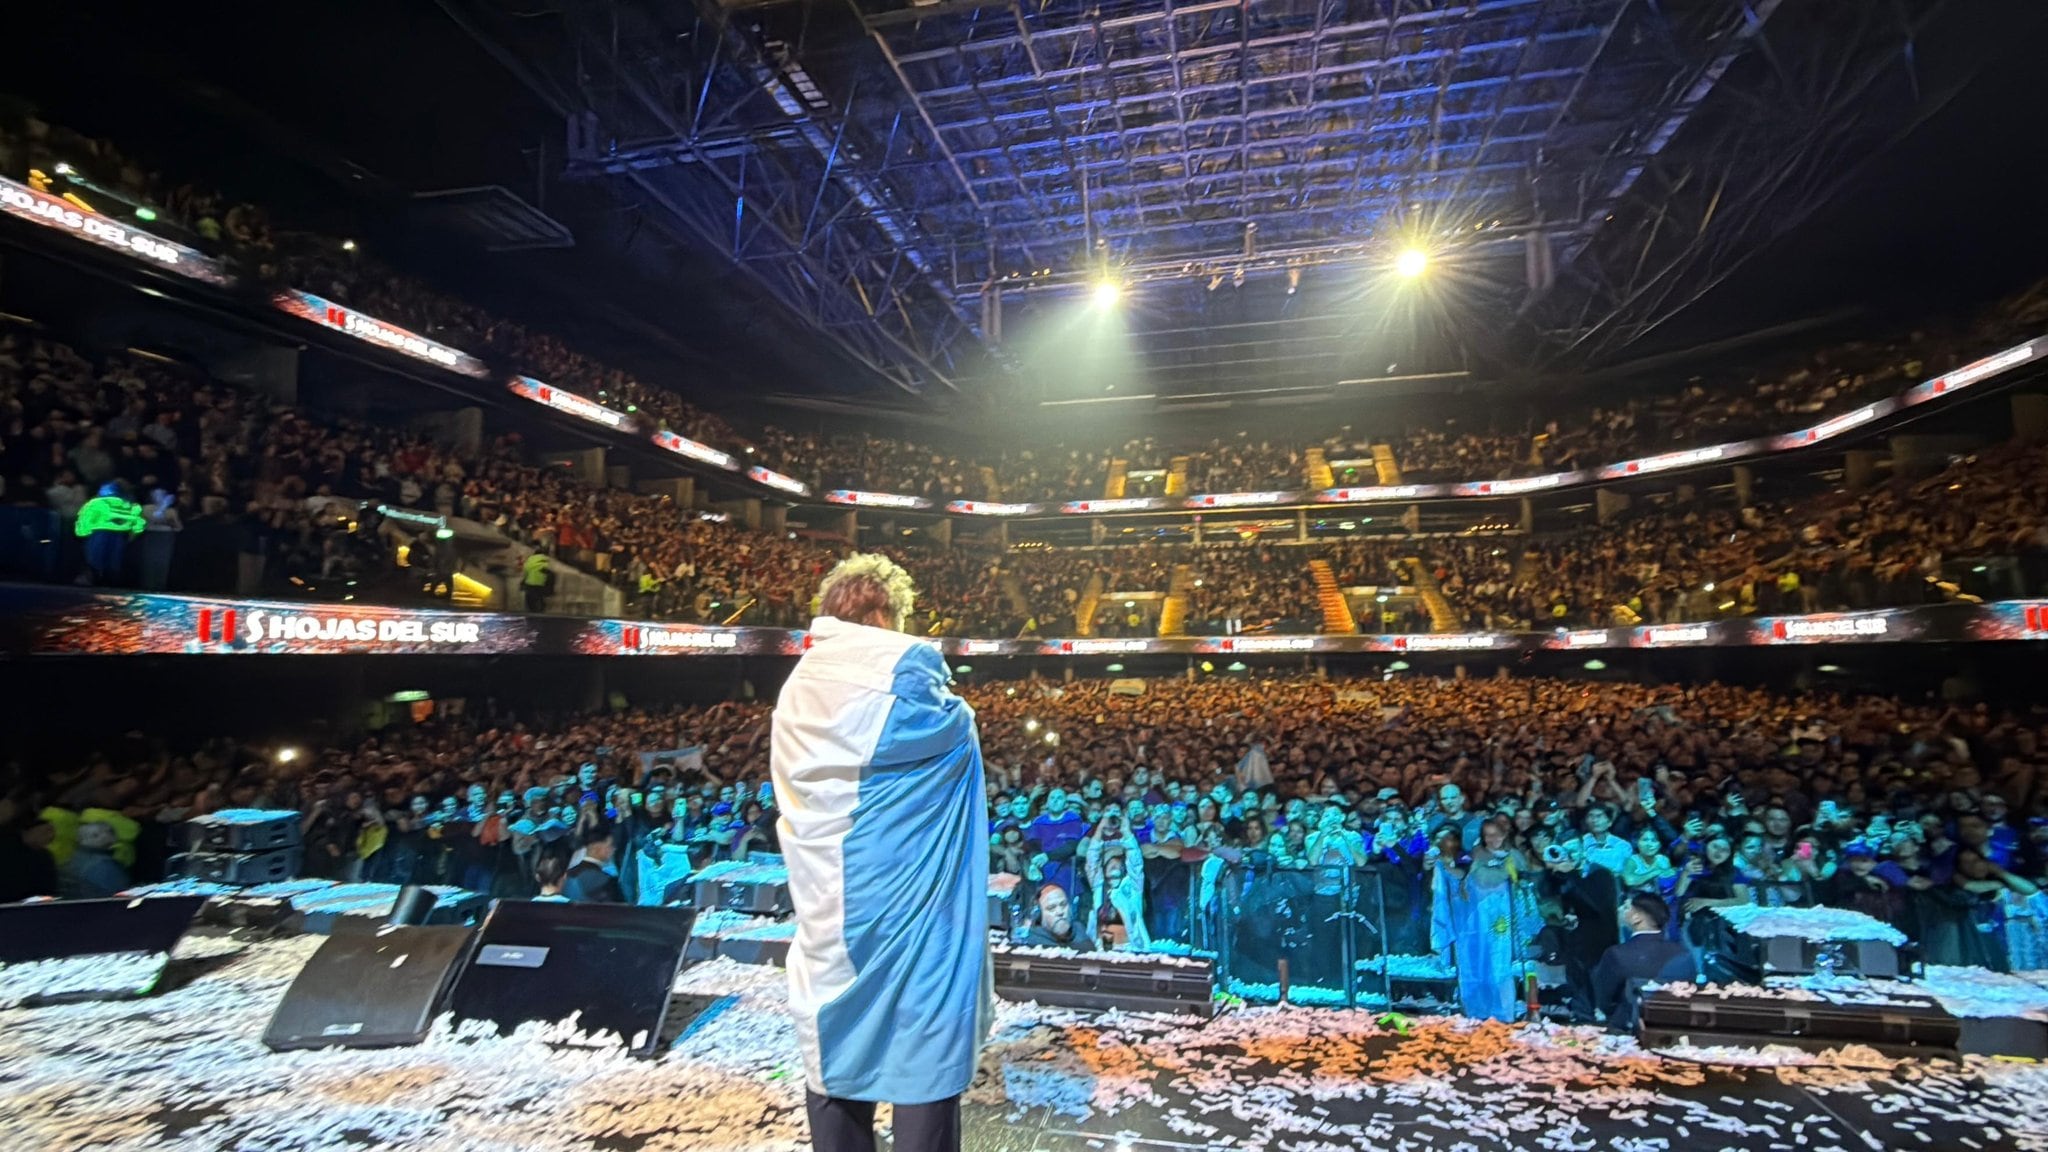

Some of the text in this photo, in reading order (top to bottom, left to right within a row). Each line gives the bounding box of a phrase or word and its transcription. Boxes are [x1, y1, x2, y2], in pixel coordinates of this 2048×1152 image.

[83, 218, 131, 246] DEL
[131, 236, 178, 264] SUR
[269, 615, 377, 641] HOJAS
[379, 619, 429, 642] DEL
[430, 621, 480, 643] SUR
